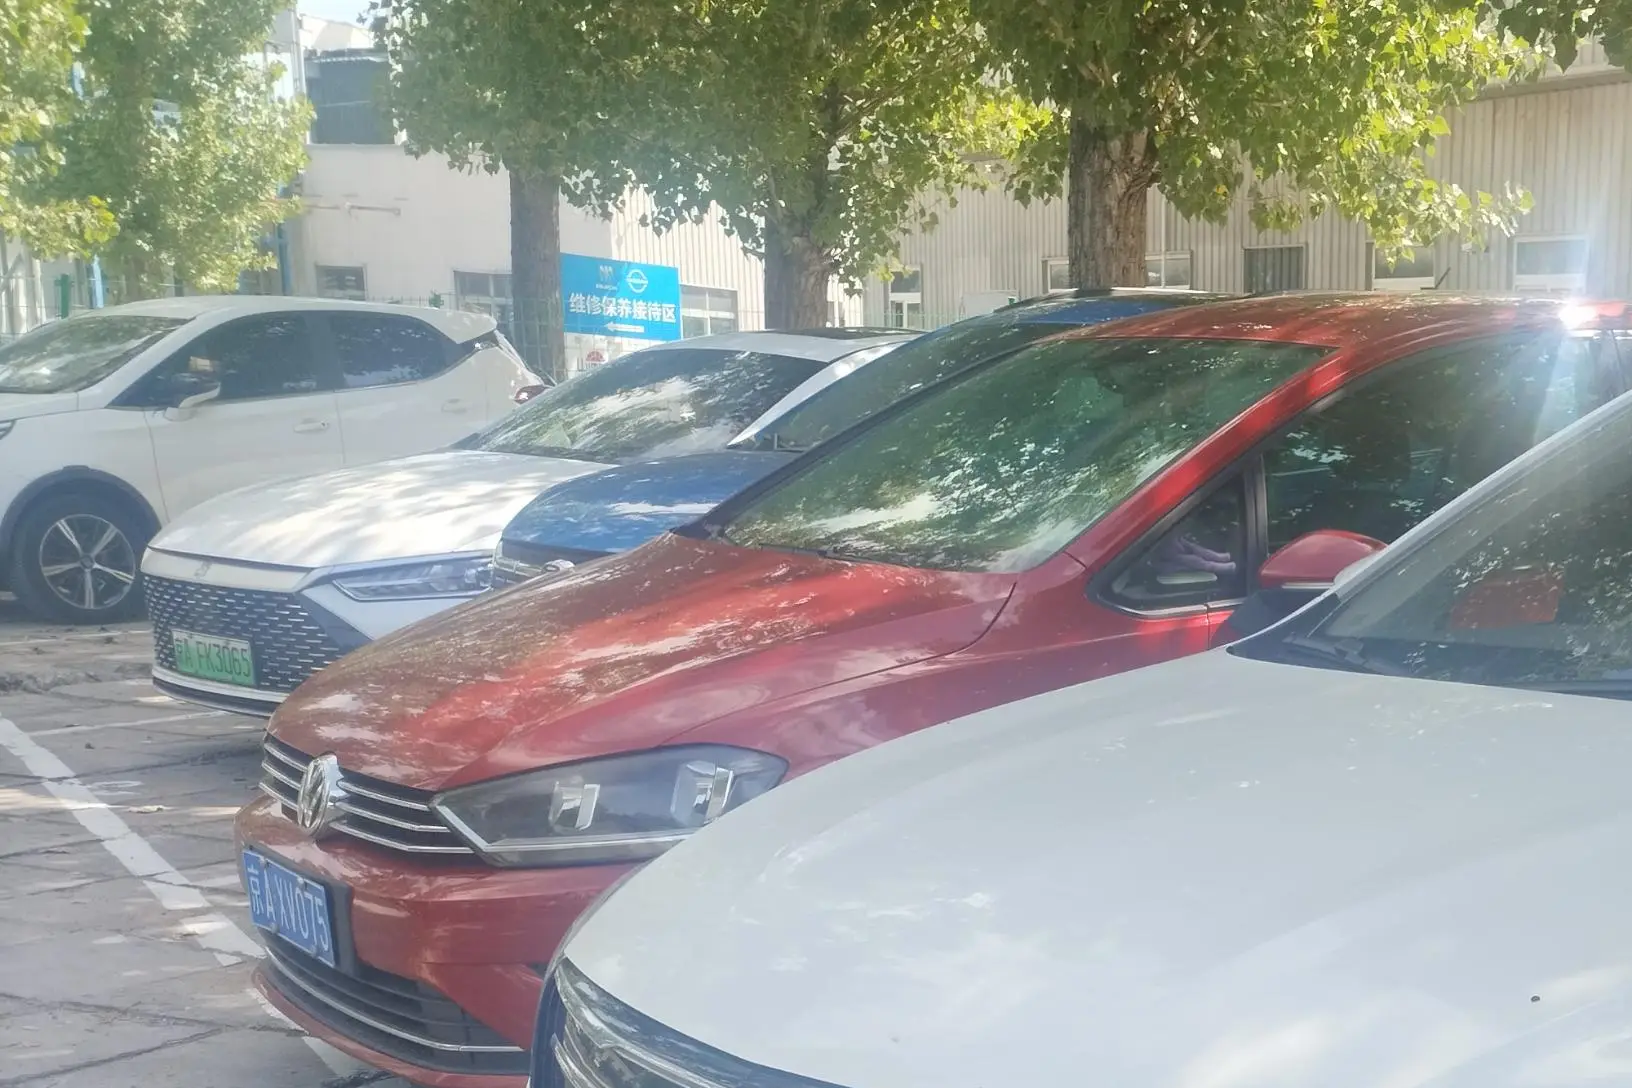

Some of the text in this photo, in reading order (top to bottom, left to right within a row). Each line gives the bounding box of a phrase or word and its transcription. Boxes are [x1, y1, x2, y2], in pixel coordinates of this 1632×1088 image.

[569, 292, 677, 325] 维修保养接待区
